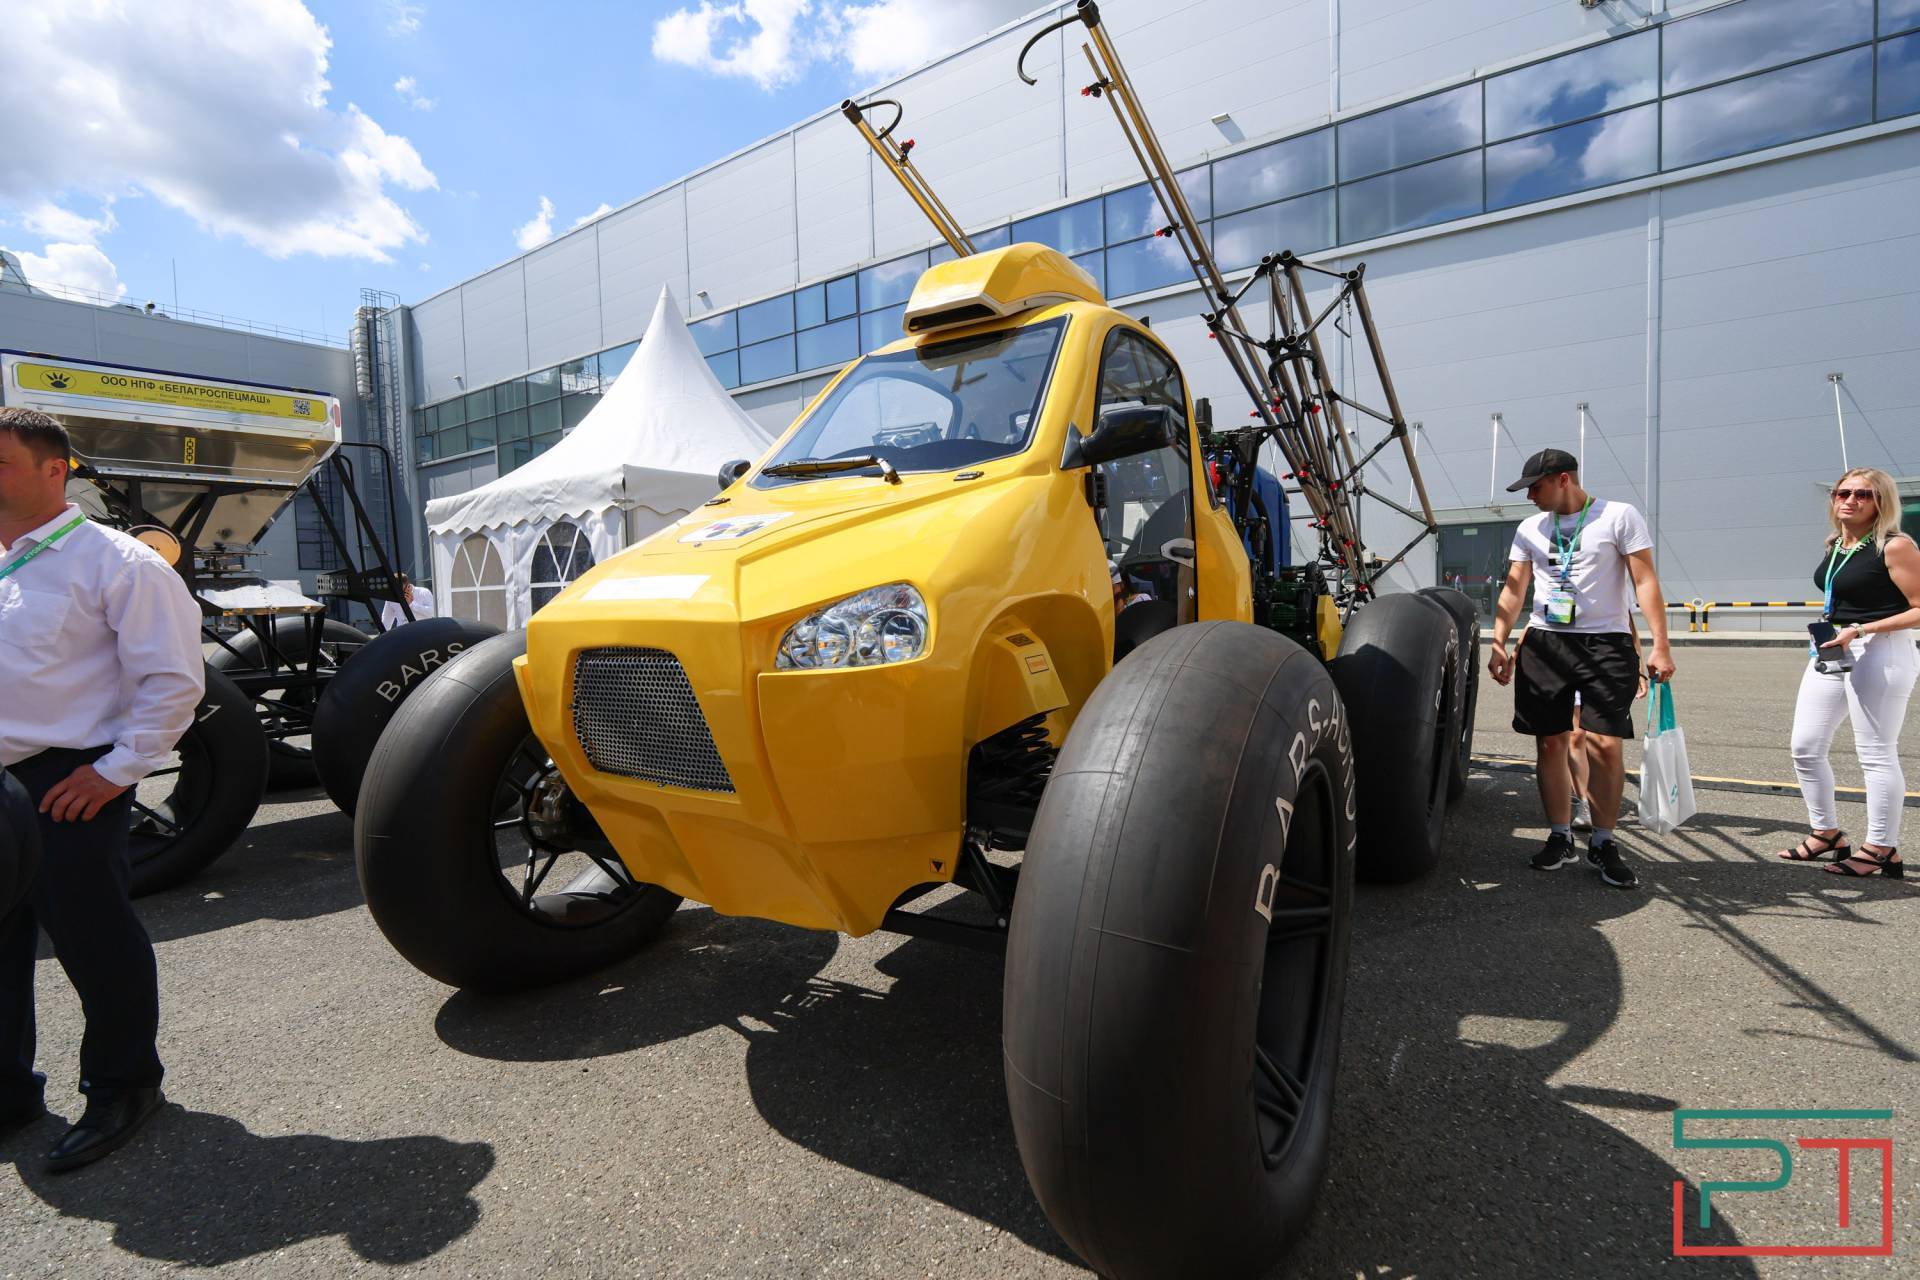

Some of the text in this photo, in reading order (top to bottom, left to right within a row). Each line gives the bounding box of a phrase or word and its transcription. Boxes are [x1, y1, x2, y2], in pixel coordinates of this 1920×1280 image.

[100, 375, 128, 387] ООО
[130, 379, 156, 390] НПФ
[159, 383, 271, 404] «БЕЛАГРОСПЕЦМАШ»
[375, 642, 464, 702] BARS
